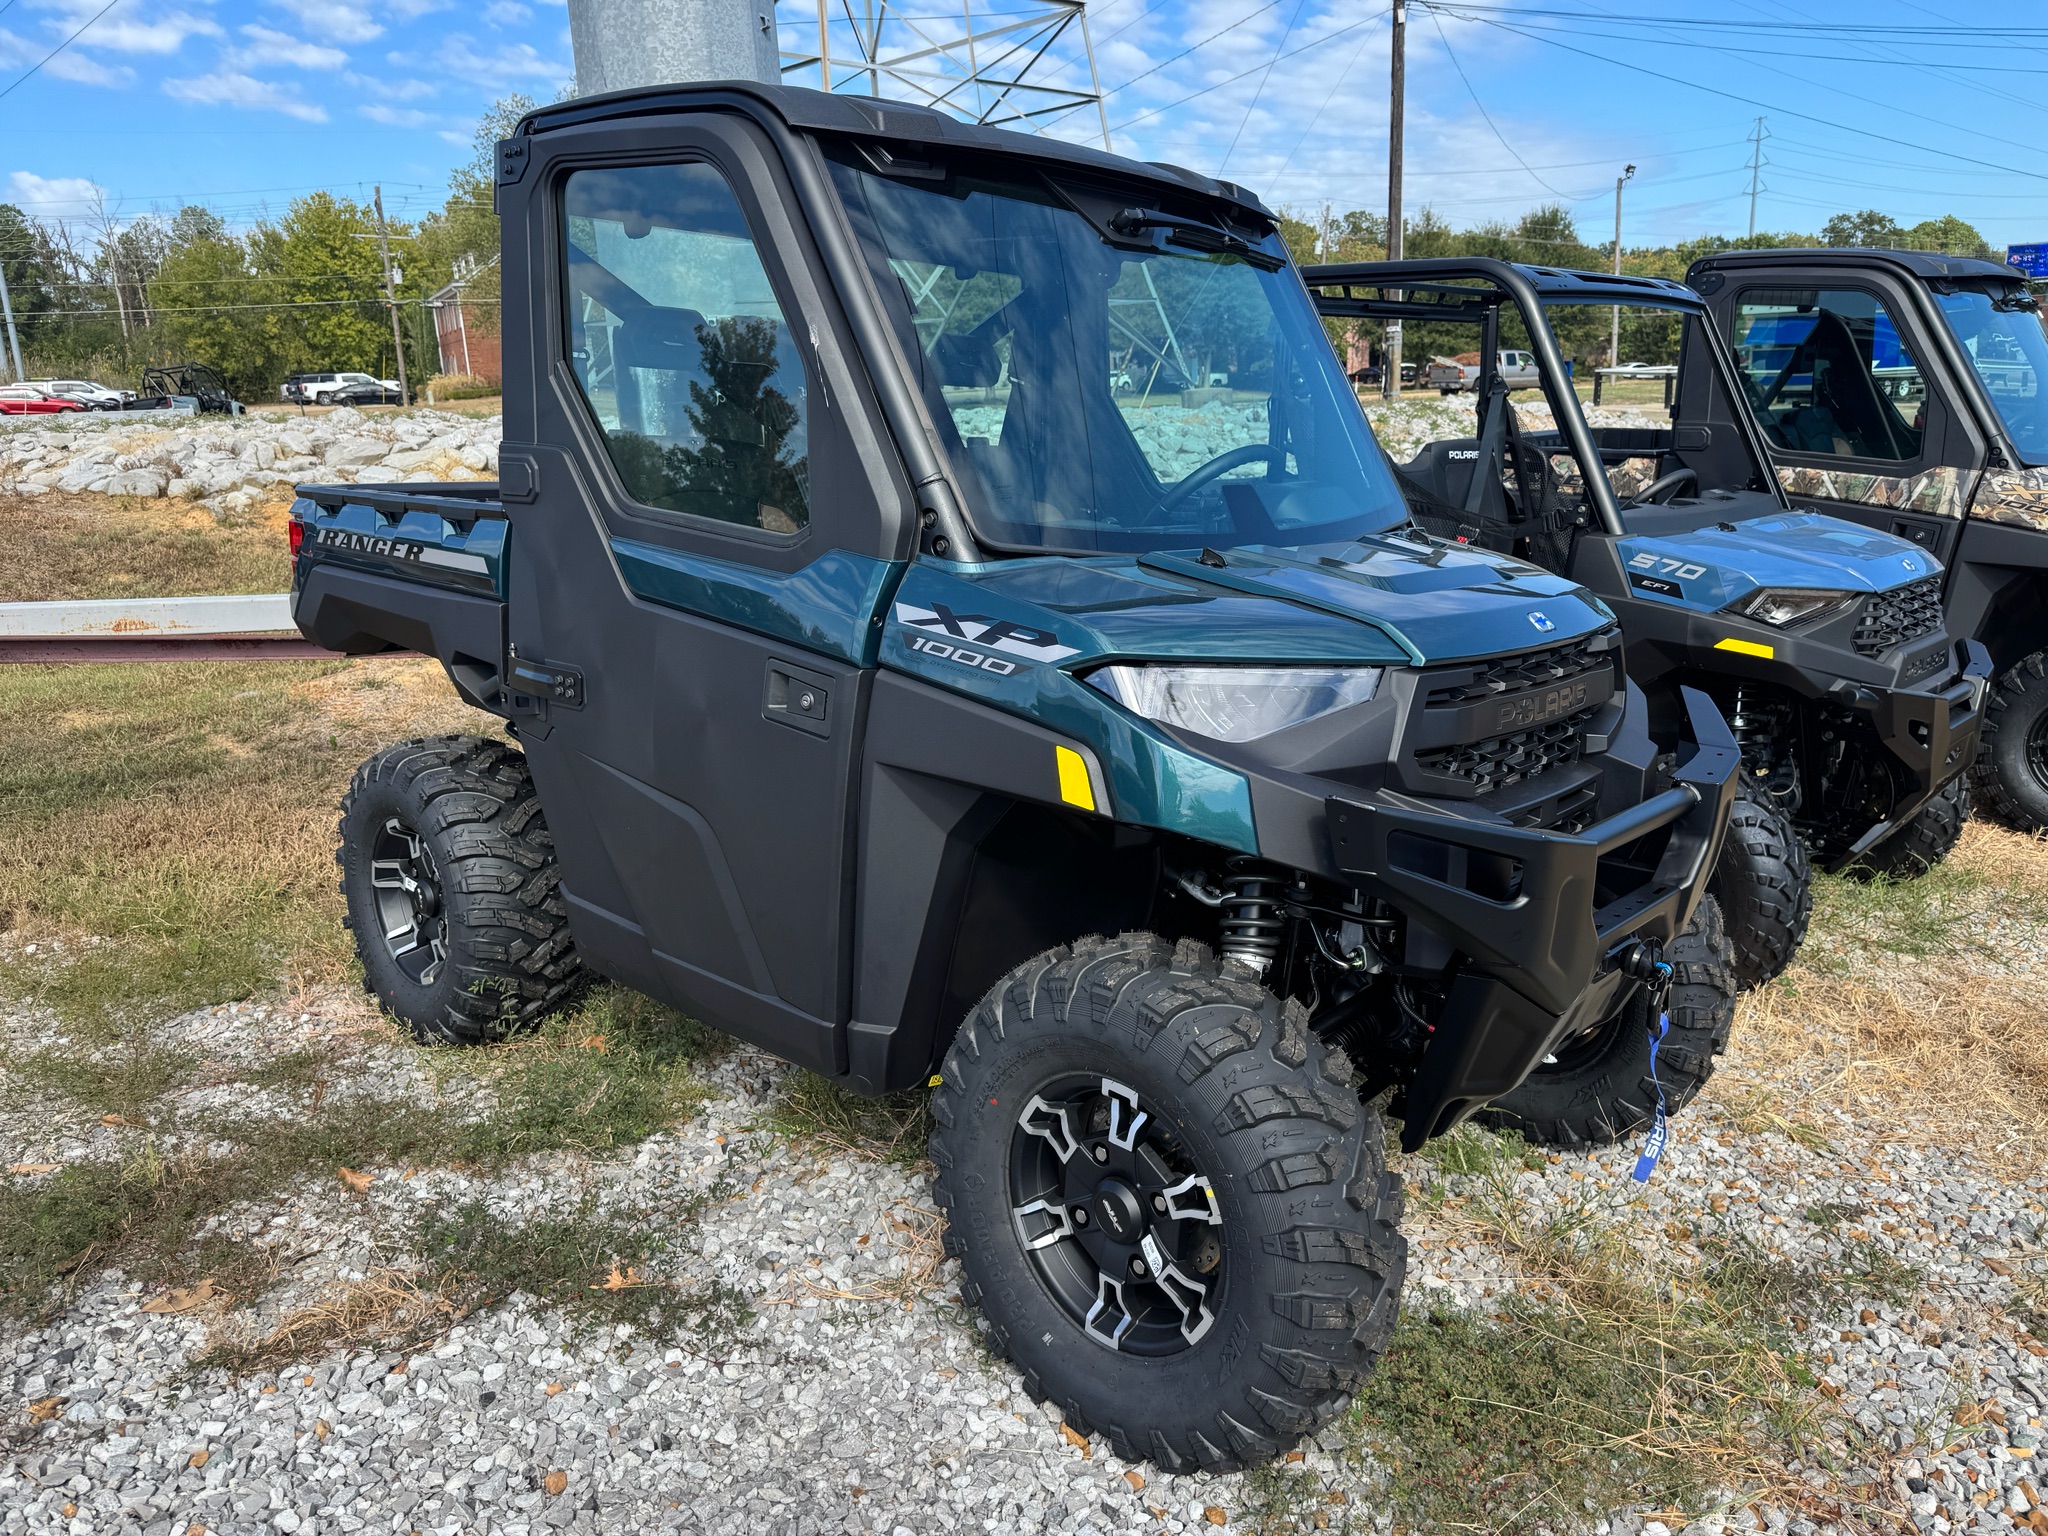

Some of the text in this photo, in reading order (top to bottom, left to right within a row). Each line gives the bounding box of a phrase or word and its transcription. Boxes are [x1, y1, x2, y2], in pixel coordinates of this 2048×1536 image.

[1448, 451, 1480, 460] POLARIS
[1995, 498, 2048, 516] 100
[320, 529, 425, 562] RANGER
[1628, 552, 1707, 580] 570
[1641, 580, 1670, 591] EFI
[903, 601, 1061, 648] XP
[904, 653, 1002, 685] DUAL OVERHEAD CAM
[912, 637, 1017, 676] 1000
[1496, 682, 1587, 730] POLARIS
[967, 1195, 1036, 1335] PRO ARMOR
